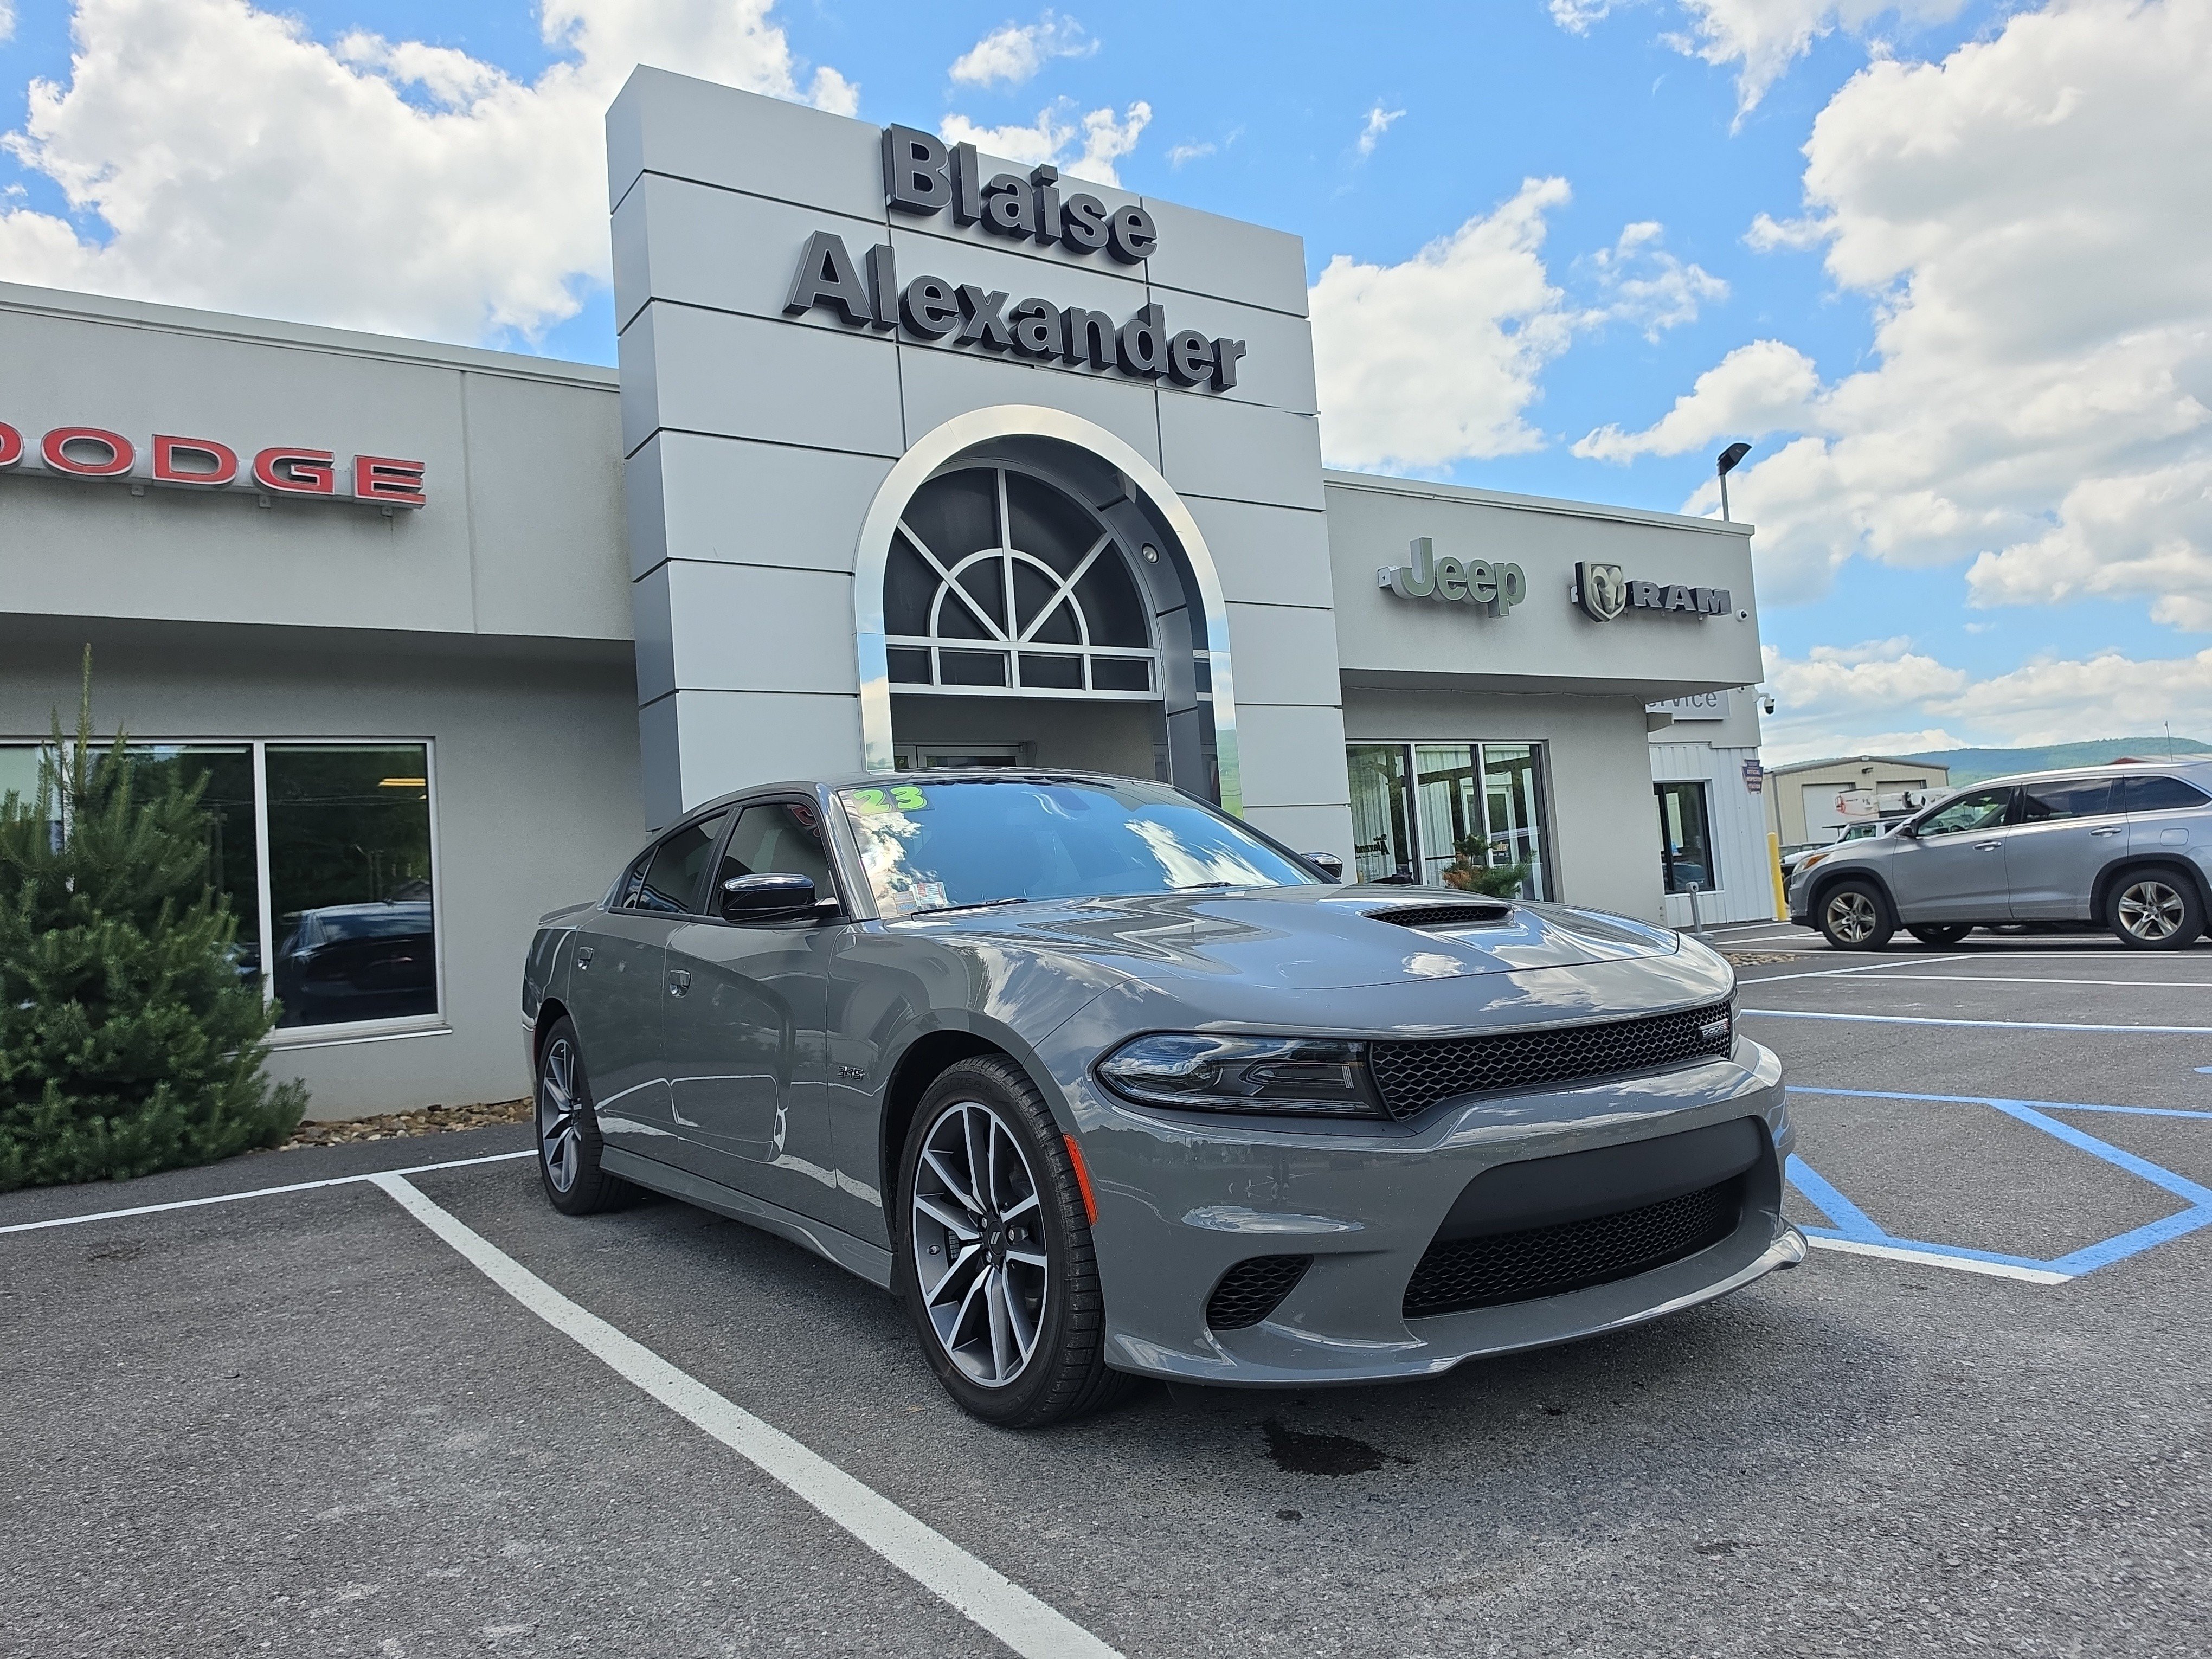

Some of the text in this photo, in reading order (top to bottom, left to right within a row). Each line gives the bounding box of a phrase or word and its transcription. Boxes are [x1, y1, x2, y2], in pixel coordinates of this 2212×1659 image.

[882, 123, 1157, 265] Blaise
[782, 230, 1246, 391] Alexander
[0, 421, 426, 510] ODGE
[1390, 537, 1527, 619] Jeep
[1625, 580, 1732, 616] RAM
[852, 786, 928, 814] 23
[837, 1066, 864, 1081] 345
